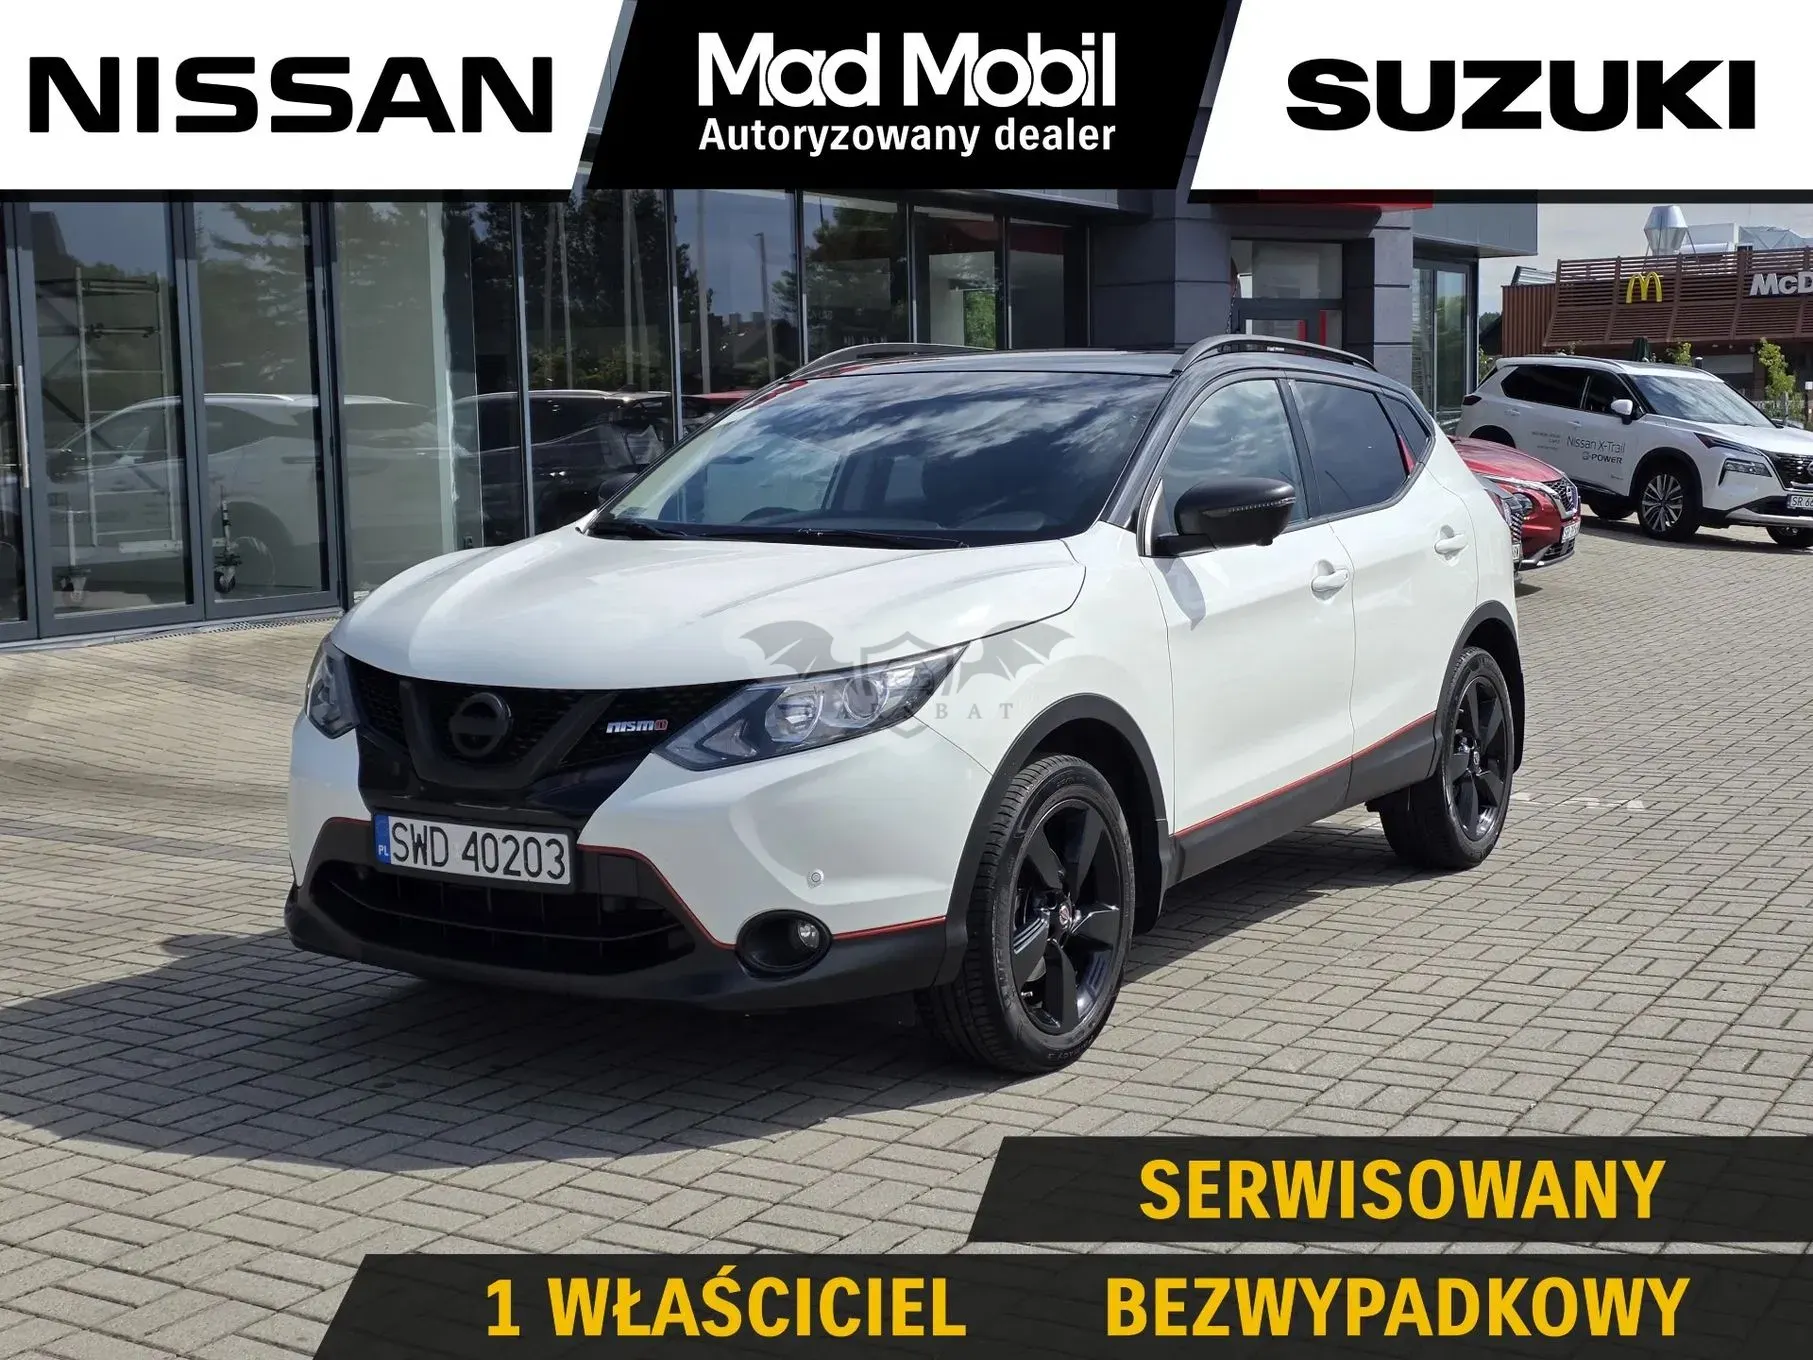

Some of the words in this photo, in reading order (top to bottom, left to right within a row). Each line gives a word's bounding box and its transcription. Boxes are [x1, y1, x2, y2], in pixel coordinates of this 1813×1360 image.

[1566, 436, 1596, 450] Nissan
[1598, 440, 1625, 454] X-Trail
[377, 844, 389, 857] PL
[391, 821, 449, 868] SWD
[461, 830, 566, 880] 40203
